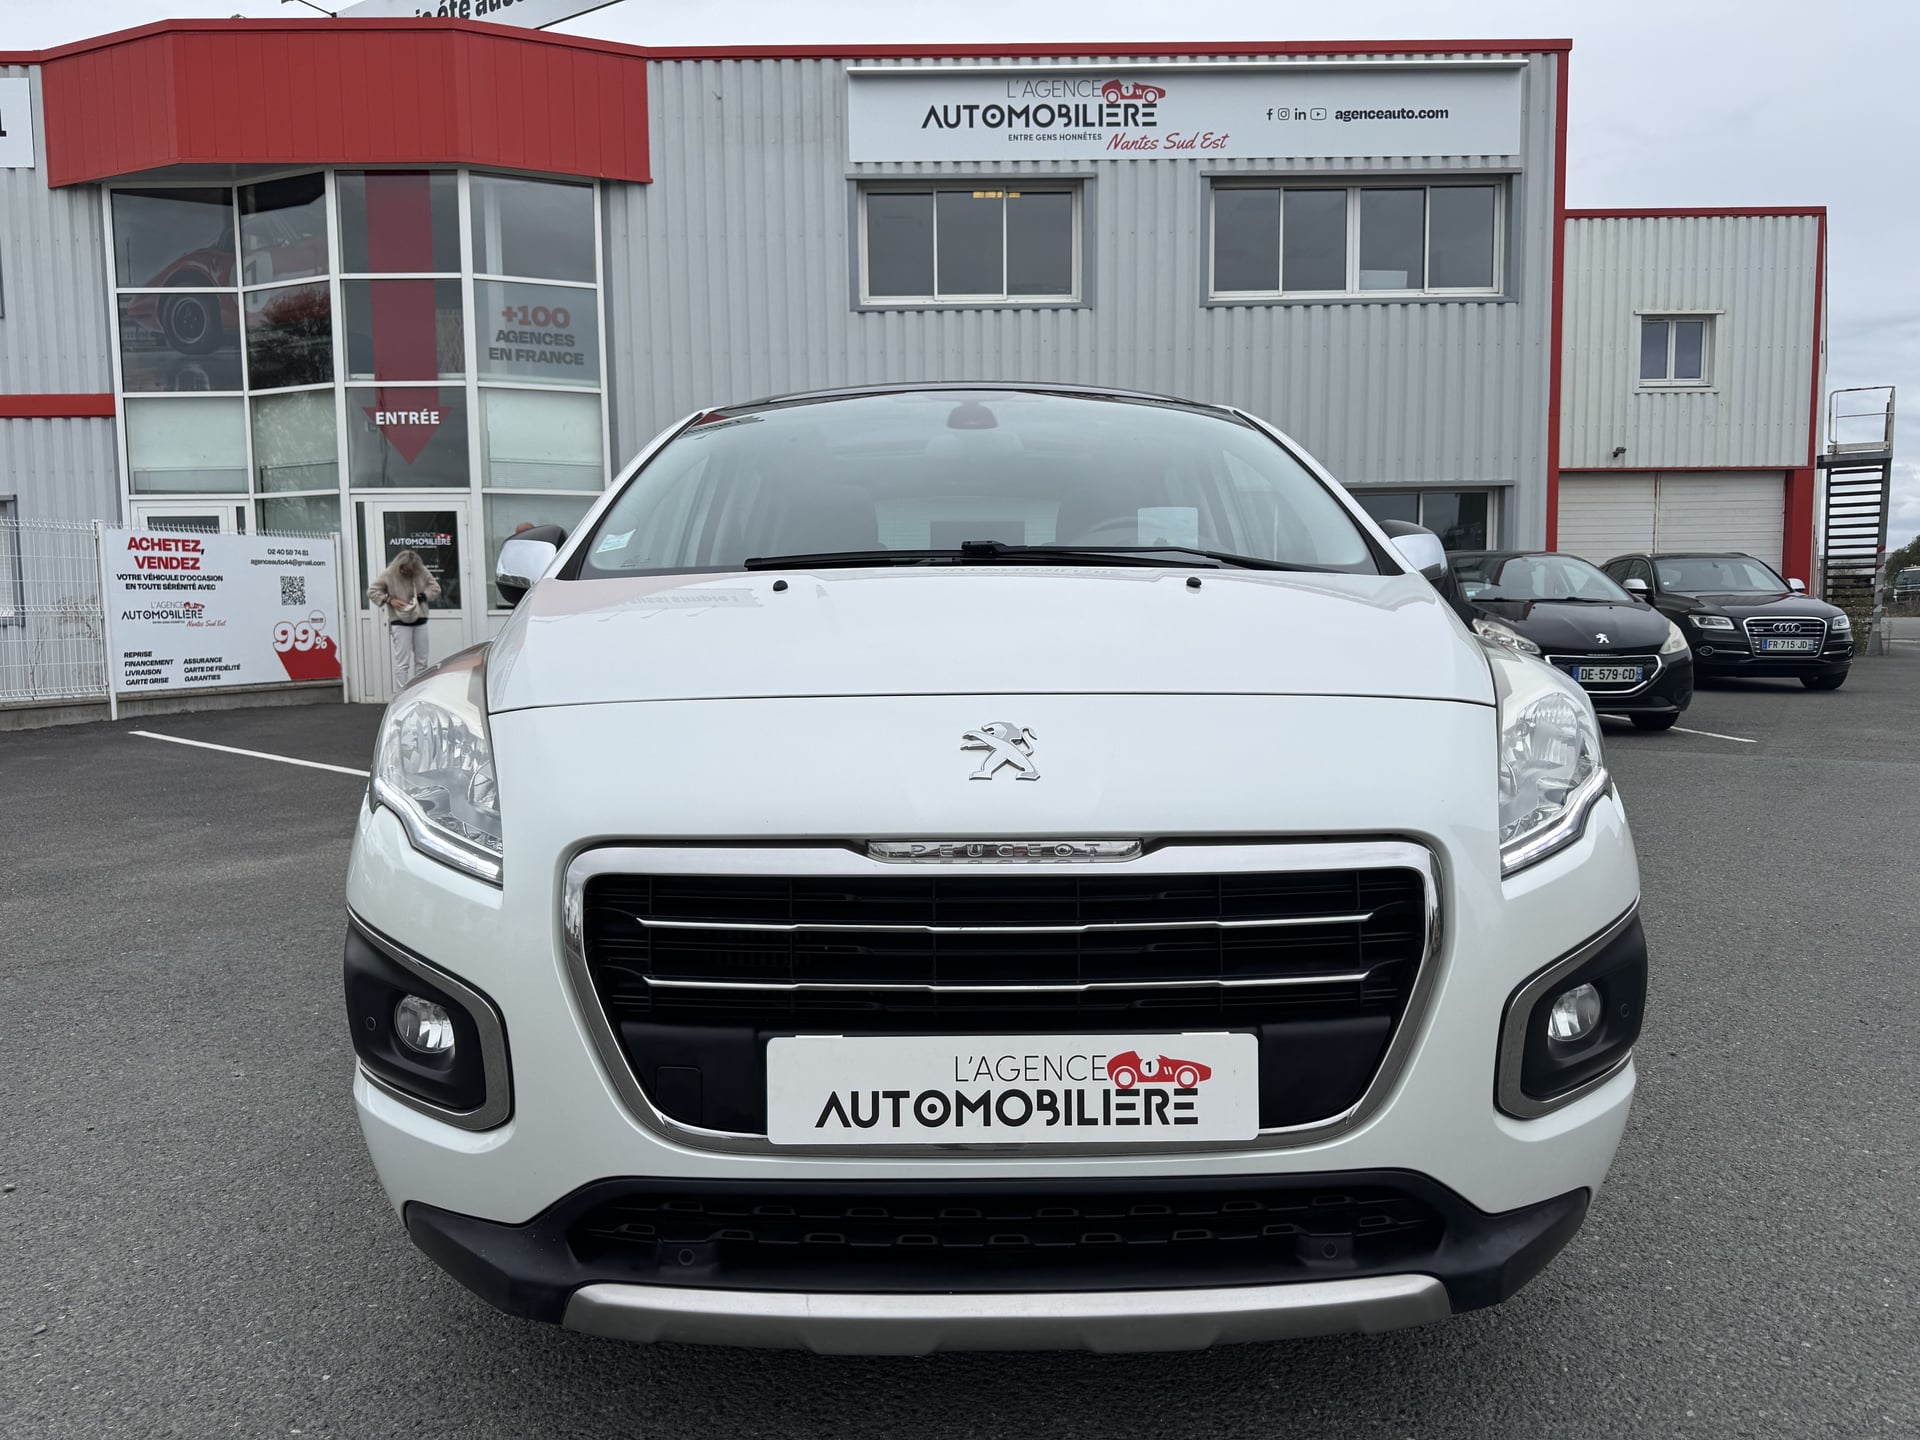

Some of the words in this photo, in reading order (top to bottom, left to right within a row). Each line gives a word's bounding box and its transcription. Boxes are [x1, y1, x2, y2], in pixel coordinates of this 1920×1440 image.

[1007, 79, 1102, 98] L'AGENCE
[1334, 107, 1449, 122] agenceauto.com
[1008, 134, 1034, 142] ENTRE
[1035, 134, 1058, 142] GENS
[1059, 132, 1102, 142] HONNÊTES
[1106, 133, 1159, 150] Nantes
[1163, 131, 1199, 150] Sud
[1200, 132, 1230, 149] Est
[501, 305, 571, 329] +100
[495, 330, 575, 347] AGENCES
[488, 347, 512, 361] EN
[515, 348, 584, 366] FRANCE
[375, 408, 440, 425] ENTRÉE
[127, 537, 205, 555] ACHETEZ,
[276, 548, 285, 556] 40
[134, 556, 201, 570] VENDEZ
[116, 573, 141, 581] VOTRE
[143, 573, 179, 581] VÉHICULE
[180, 574, 223, 582] D'OCCASION
[162, 582, 197, 591] SÉRÉNITÉ
[197, 583, 216, 591] AVEC
[123, 650, 153, 658] REPRISE
[183, 656, 223, 664] ASSURANCE
[124, 659, 174, 667] FINANCEMENT
[184, 665, 205, 673] CARTE
[215, 663, 241, 672] FIDÉLITÉ
[125, 668, 162, 676] LIVRAISON
[184, 674, 221, 682] GARANTIES
[126, 678, 148, 686] CARTE
[910, 843, 1100, 857] PEUGEOT
[954, 1054, 1107, 1083] L'AGENCE
